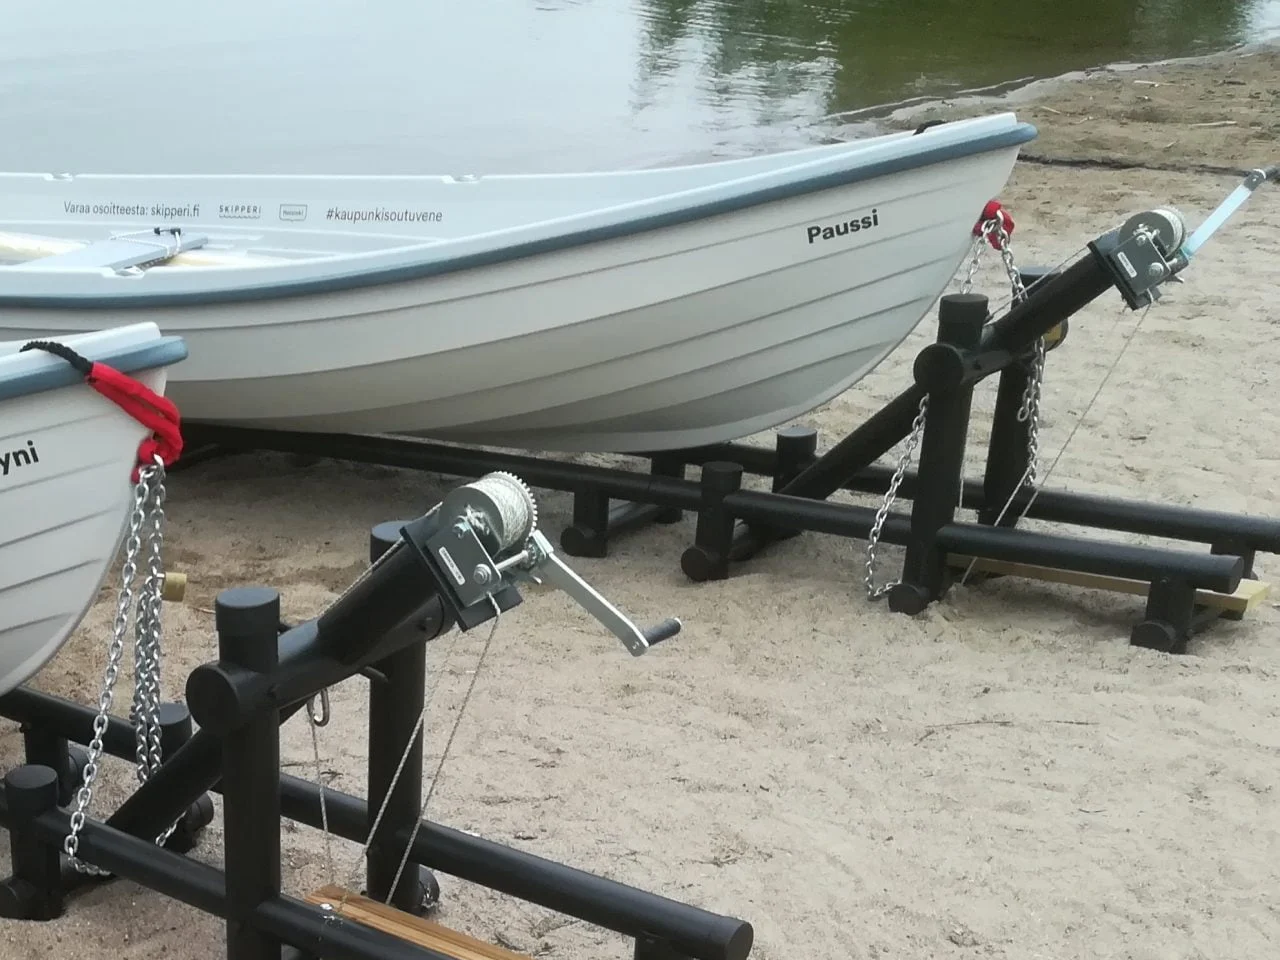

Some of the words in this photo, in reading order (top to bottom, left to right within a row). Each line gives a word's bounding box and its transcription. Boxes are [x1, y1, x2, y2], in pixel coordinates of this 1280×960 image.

[64, 200, 90, 214] Varaa
[92, 202, 148, 216] osoitteesta:
[151, 203, 200, 219] skipperi.fi
[219, 204, 261, 214] SKIPPERI
[326, 207, 443, 224] #kaupunkisoutuvene
[807, 208, 879, 244] Paussi
